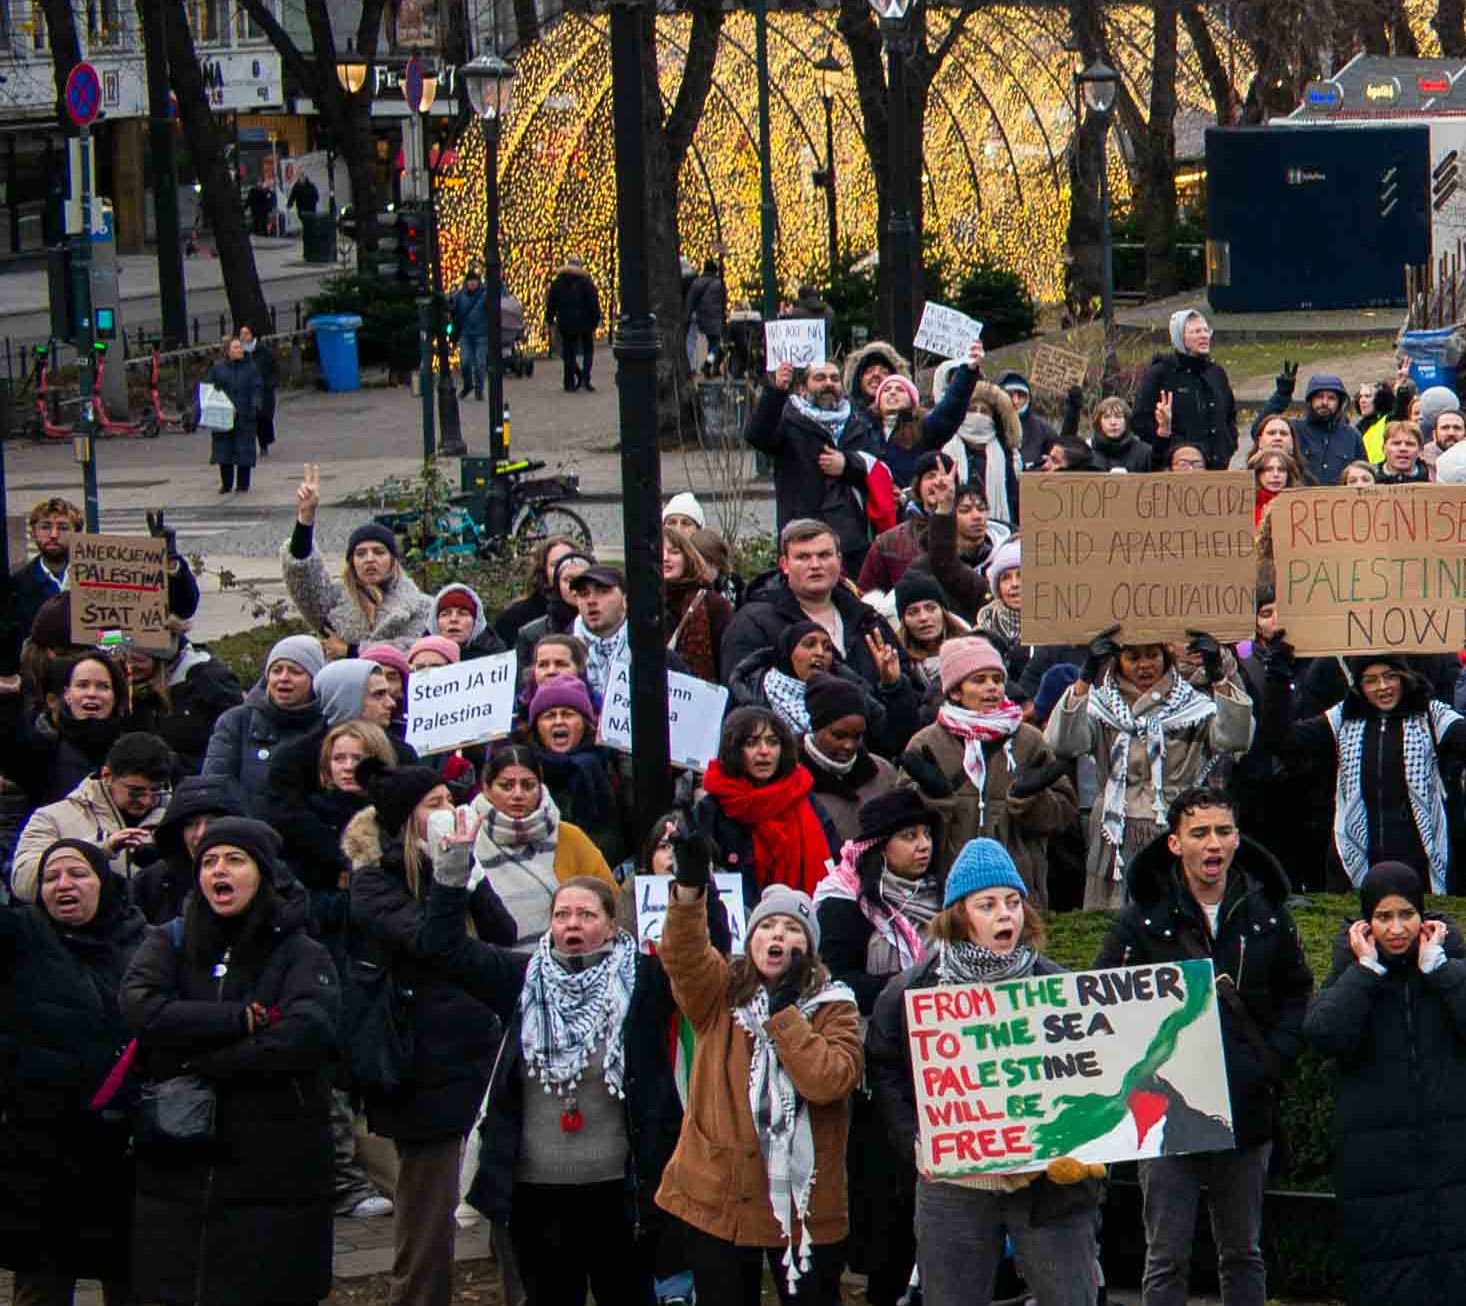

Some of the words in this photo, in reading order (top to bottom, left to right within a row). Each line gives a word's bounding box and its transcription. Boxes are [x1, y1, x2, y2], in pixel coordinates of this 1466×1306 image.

[1033, 477, 1120, 522] STOP
[1135, 483, 1251, 519] GENOCIDE
[74, 542, 164, 564] ANERKJENN
[1034, 529, 1095, 567] END
[1107, 529, 1257, 564] APARTHEID
[74, 565, 165, 589] PALESTINA
[79, 603, 134, 626] STAT
[1032, 581, 1093, 622] END
[1111, 581, 1255, 621] OCCUPATION
[413, 679, 460, 702] Stem
[464, 673, 485, 692] JA
[489, 664, 509, 685] til
[411, 702, 493, 734] Palestina
[911, 988, 996, 1025] FROM
[996, 976, 1065, 1010] THE
[1075, 965, 1185, 1007] RIVER
[911, 1029, 961, 1062] TO
[962, 1017, 1036, 1051] THE
[1042, 1012, 1115, 1044] SEA
[921, 1050, 1103, 1097] PALESTINE
[925, 1099, 1005, 1127] WILL
[1006, 1093, 1047, 1119] BE
[930, 1125, 1035, 1167] FREE
